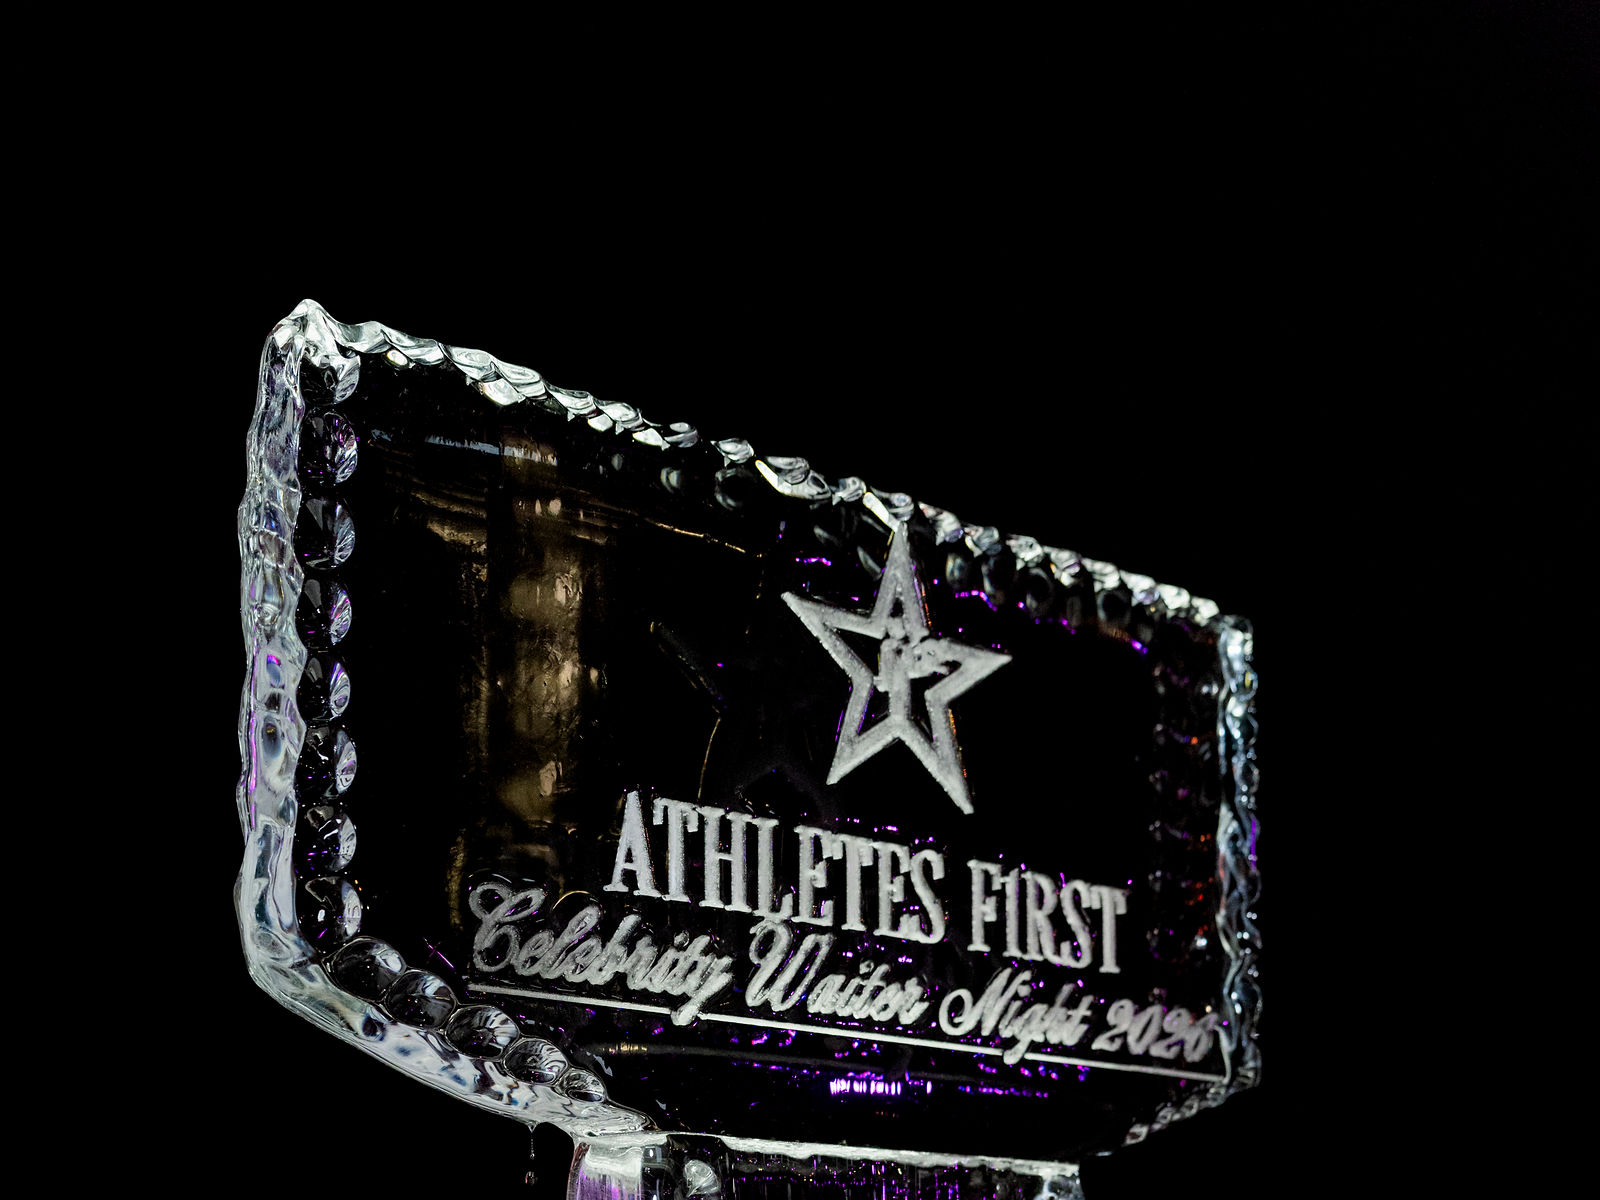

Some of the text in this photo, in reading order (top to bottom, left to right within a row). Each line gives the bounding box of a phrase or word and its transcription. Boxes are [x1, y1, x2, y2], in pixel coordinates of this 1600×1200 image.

[603, 790, 946, 945] ATHLETES
[468, 880, 734, 1026] Celebrity
[745, 920, 930, 1025] Waiter
[938, 966, 1095, 1065] Night
